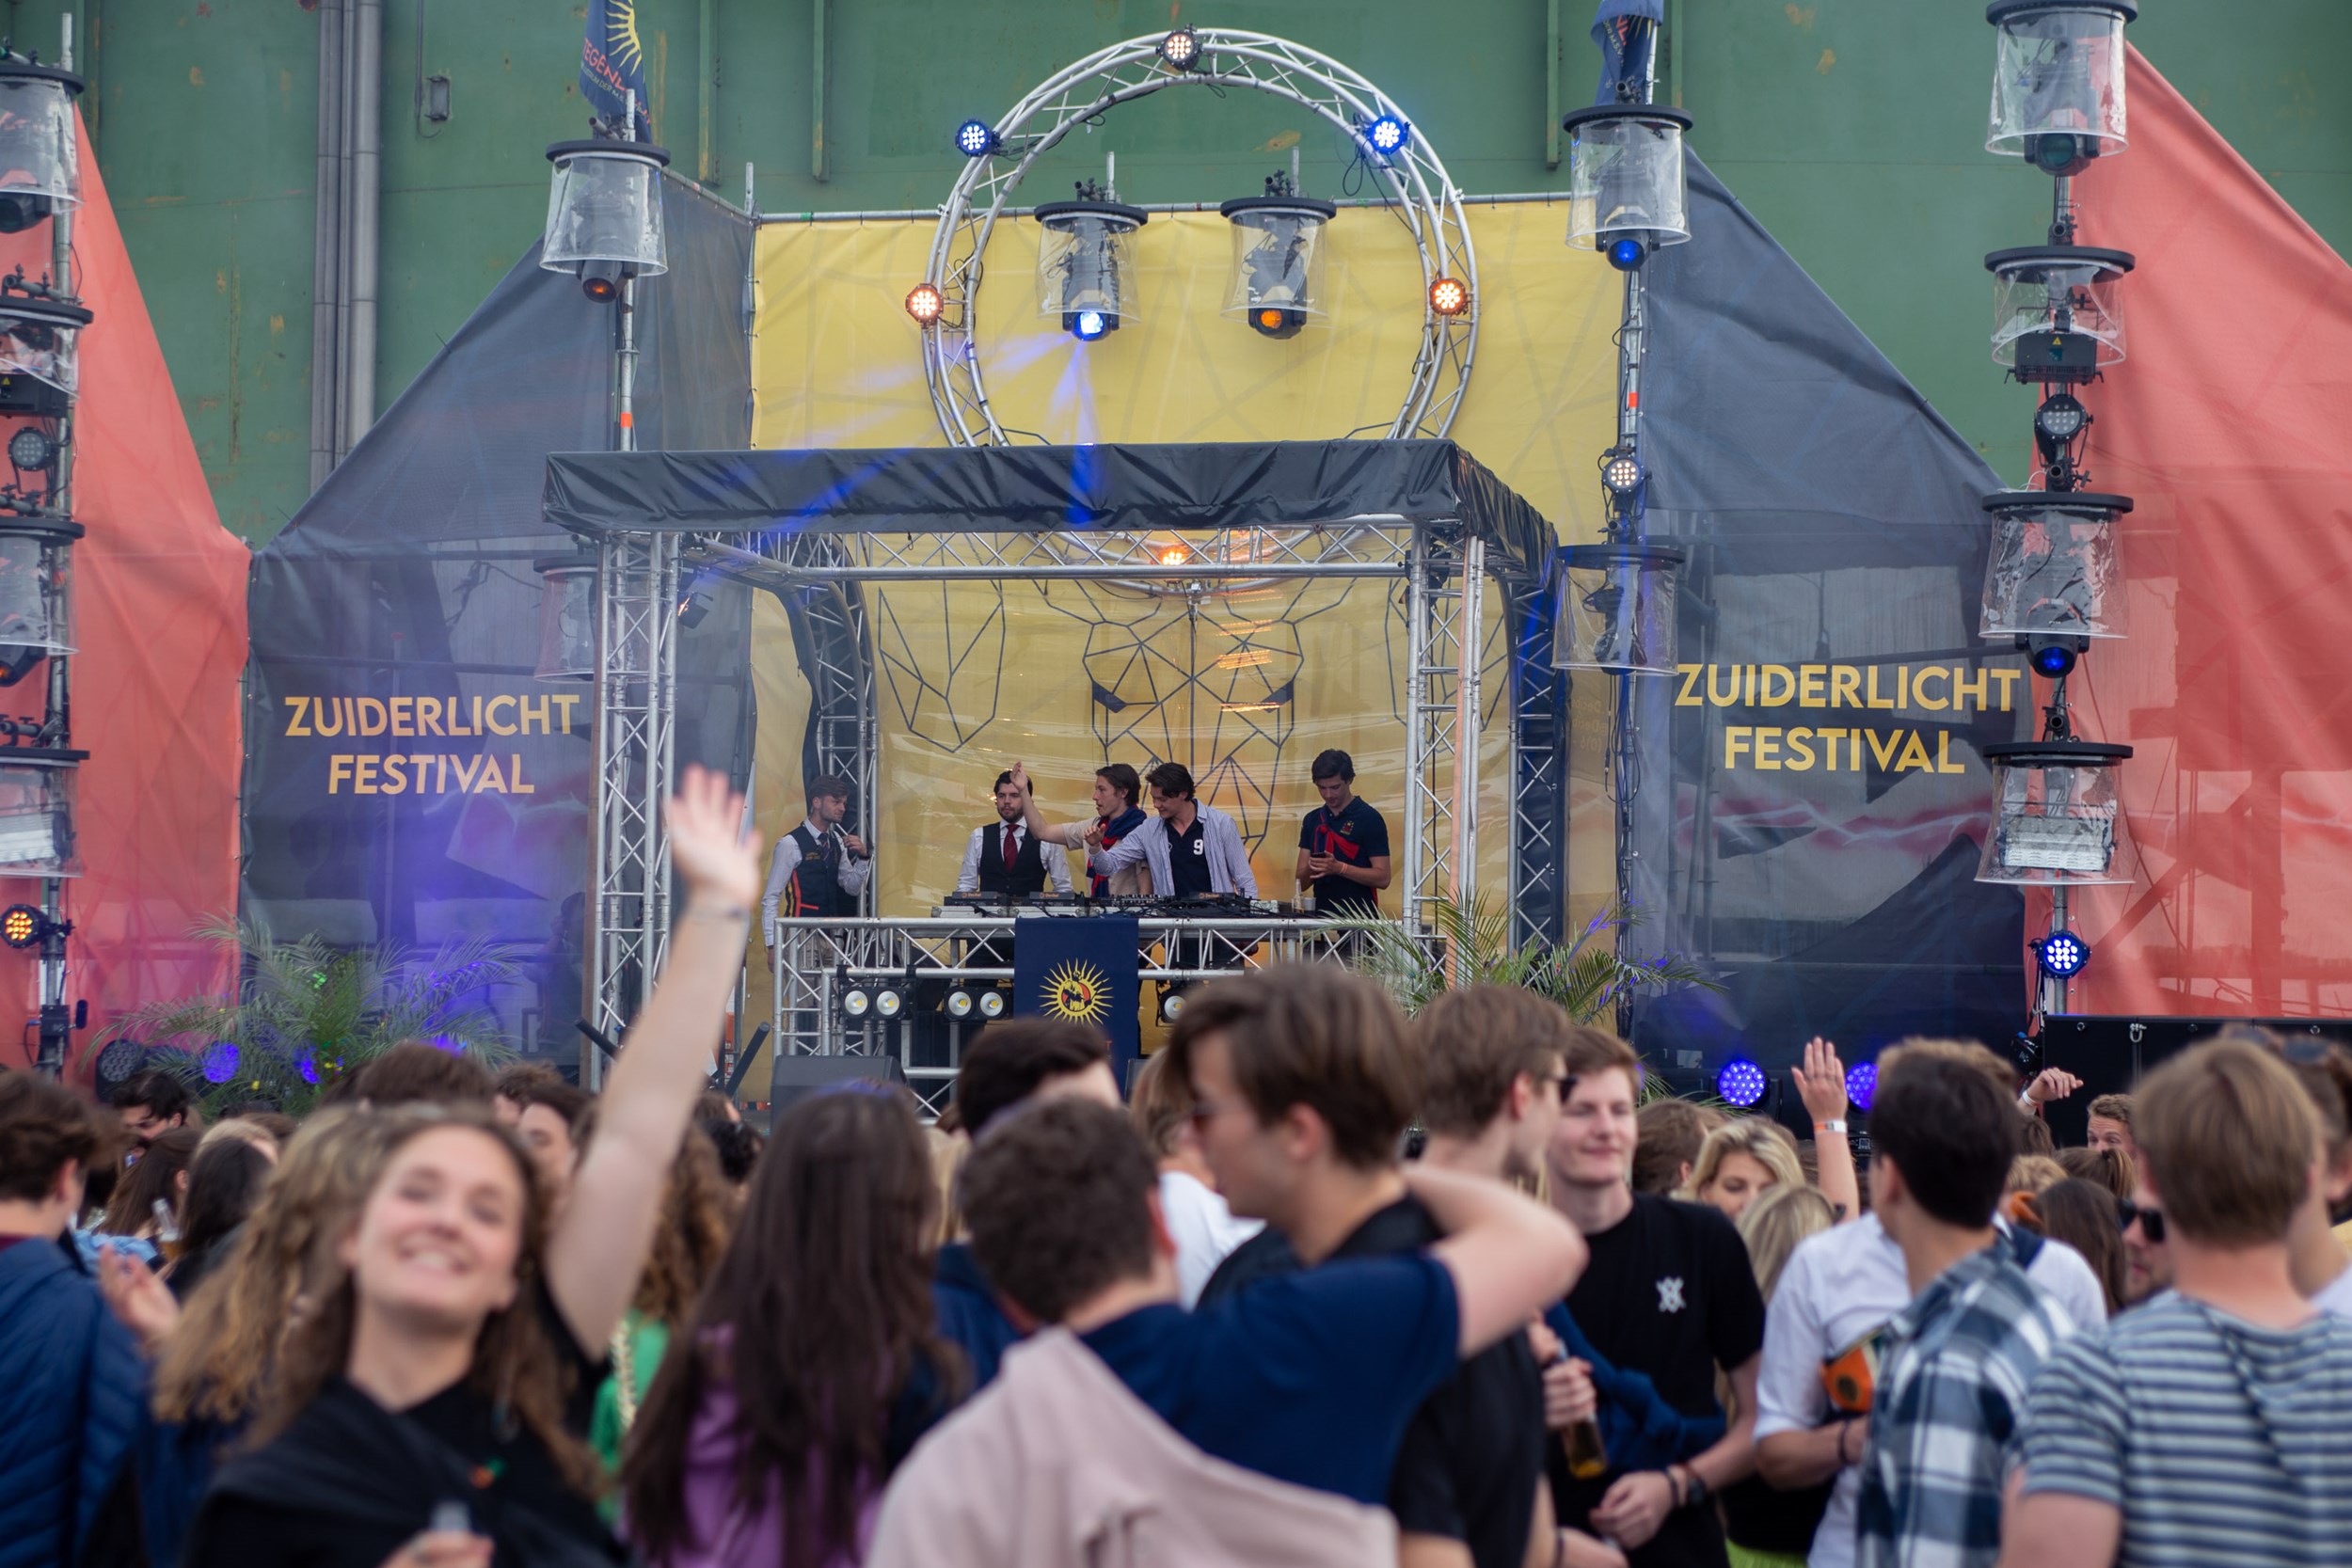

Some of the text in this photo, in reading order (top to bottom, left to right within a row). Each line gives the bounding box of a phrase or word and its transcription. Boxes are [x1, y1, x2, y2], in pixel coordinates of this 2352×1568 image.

[1675, 663, 2021, 712] ZUIDERLICHT
[285, 694, 580, 736] ZUIDERLICHT
[1724, 726, 1965, 774] FESTIVAL
[328, 754, 535, 795] FESTIVAL
[1193, 838, 1204, 855] 9
